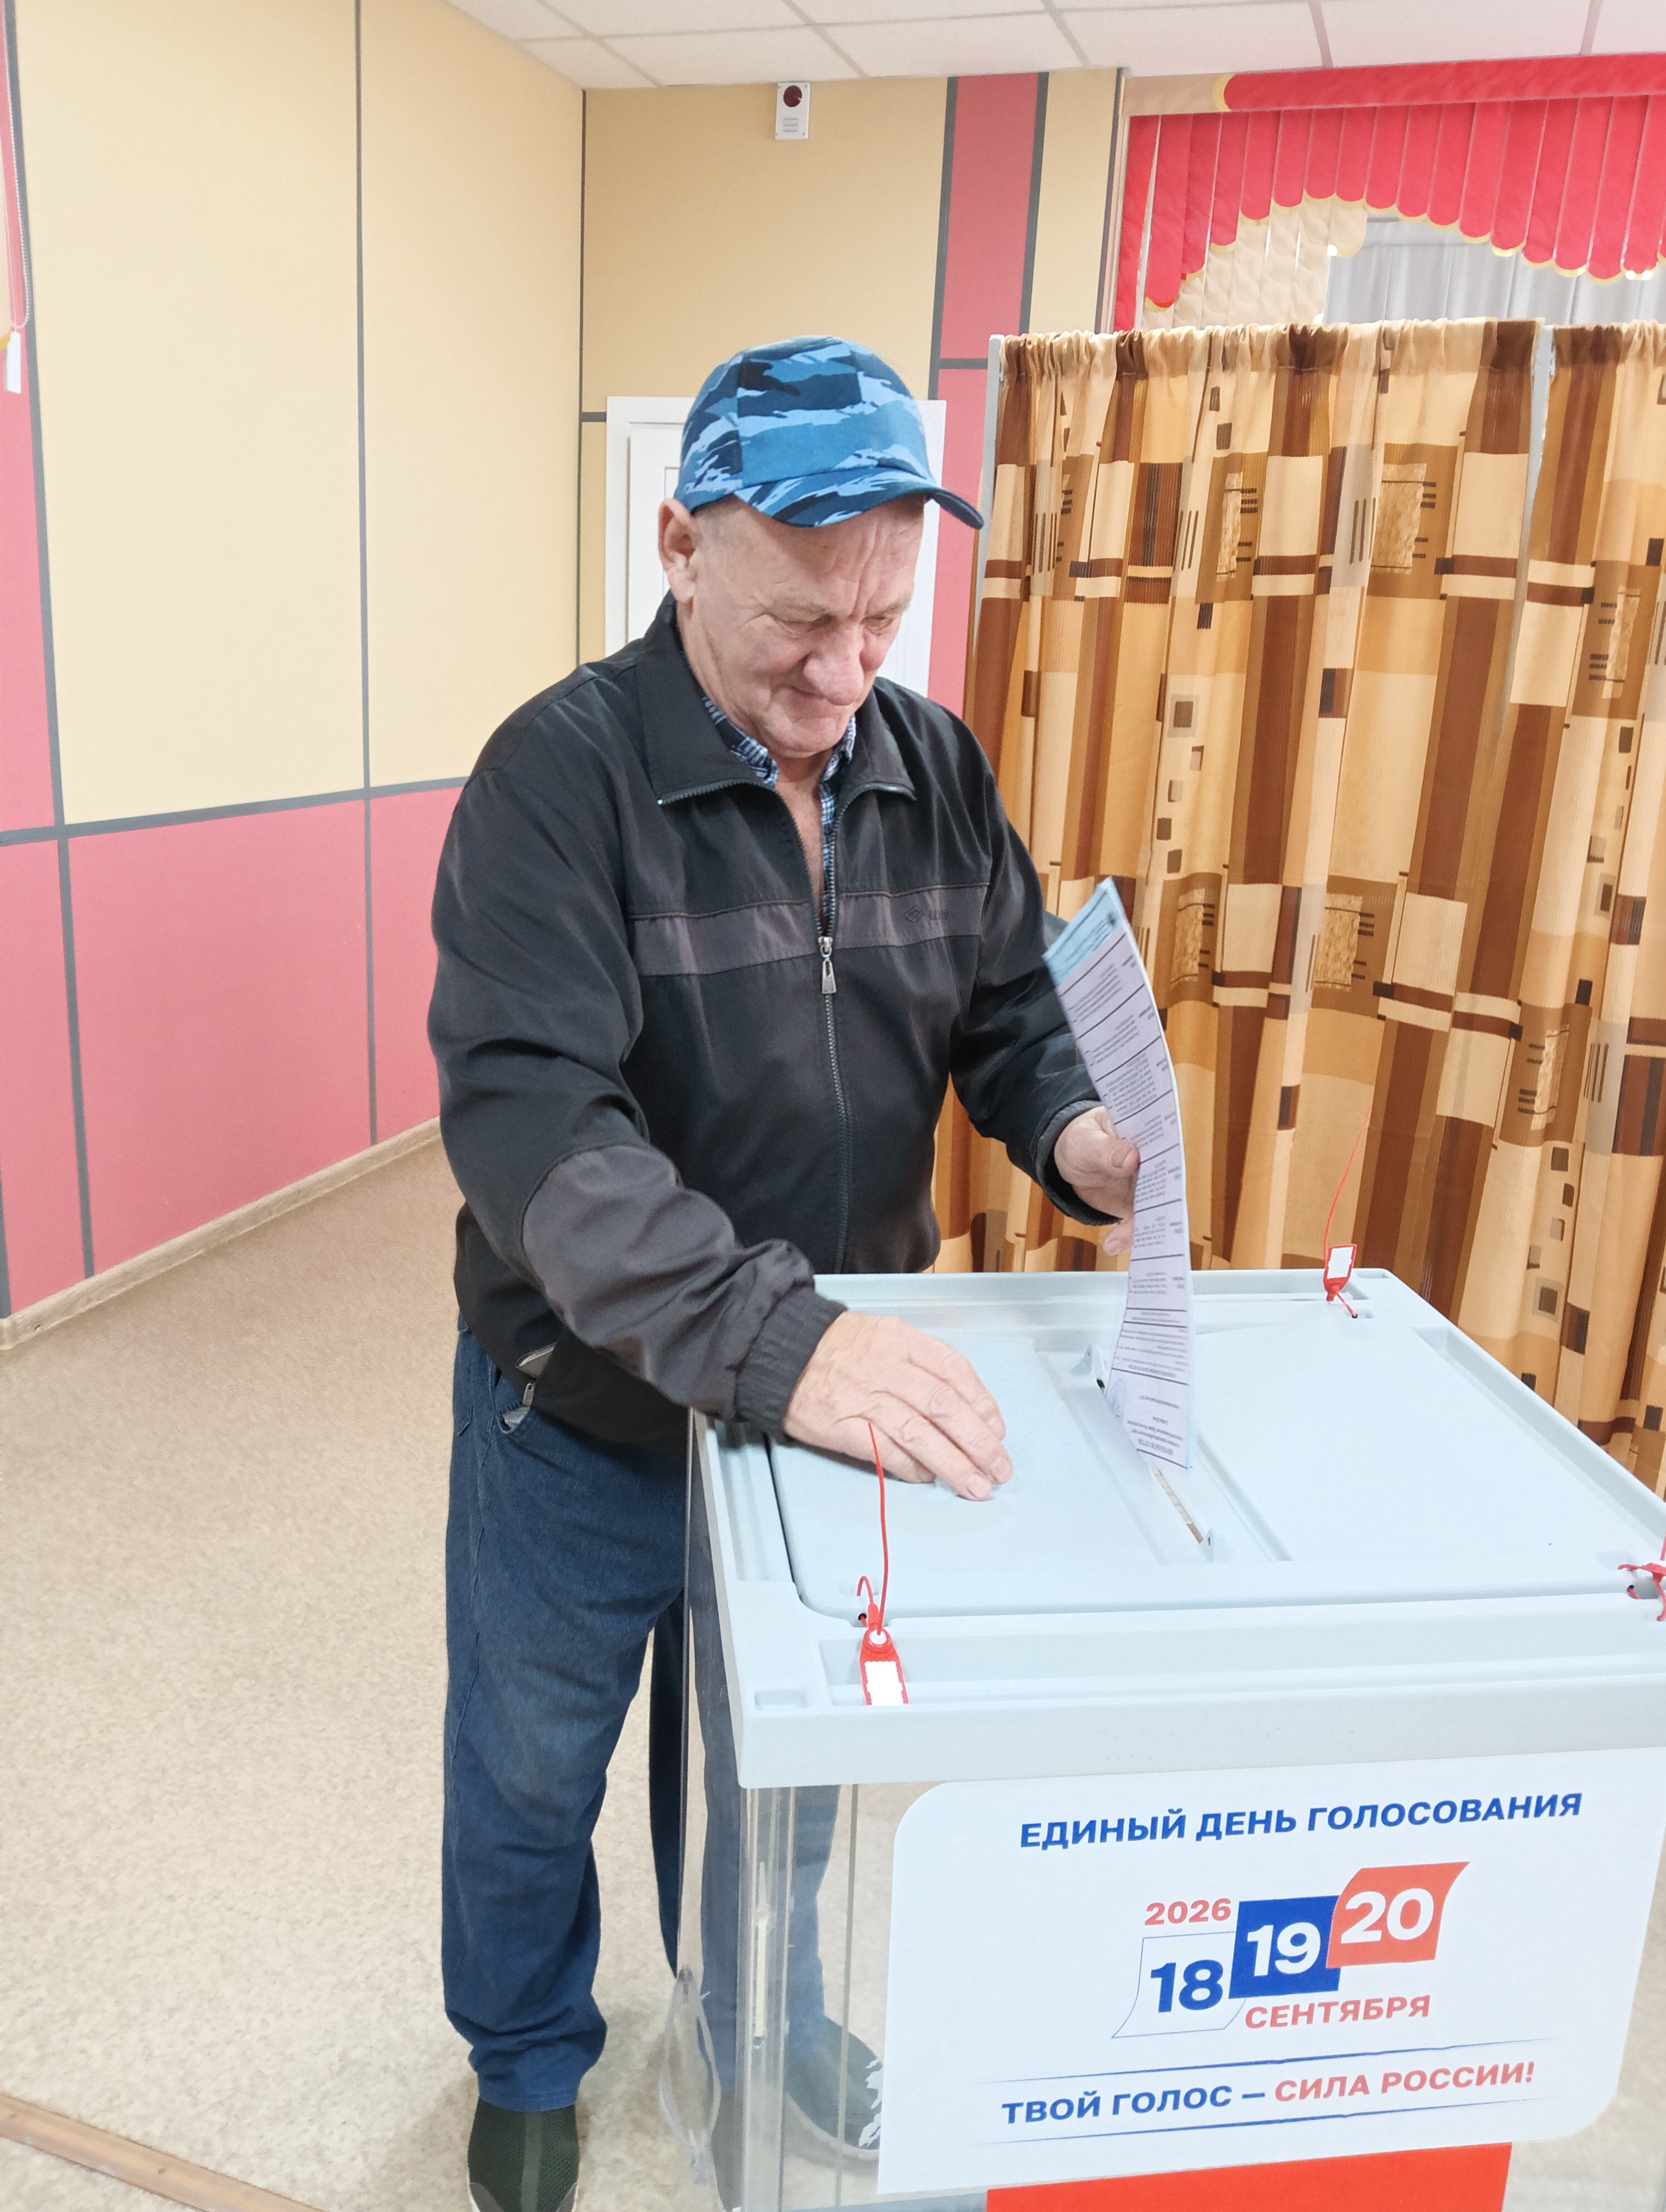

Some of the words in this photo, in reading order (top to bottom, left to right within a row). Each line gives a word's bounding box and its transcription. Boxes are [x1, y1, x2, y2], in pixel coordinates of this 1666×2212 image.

[1020, 1808, 1186, 1850] ЕДИНЫЙ
[1195, 1809, 1297, 1842] ДЕНЬ
[1308, 1793, 1582, 1831] ГОЛОСОВАНИЯ
[1145, 1898, 1231, 1926] 2026
[1150, 1959, 1224, 2013] 18
[1247, 1922, 1321, 1977] 19
[1340, 1888, 1434, 1945] 20
[1245, 1995, 1430, 2029] СЕНТЯБРЯ
[1001, 2090, 1101, 2124] ТВОЙ
[1112, 2085, 1232, 2115] ГОЛОС
[1275, 2075, 1369, 2102] СИЛА
[1381, 2062, 1534, 2094] РОССИИ!
